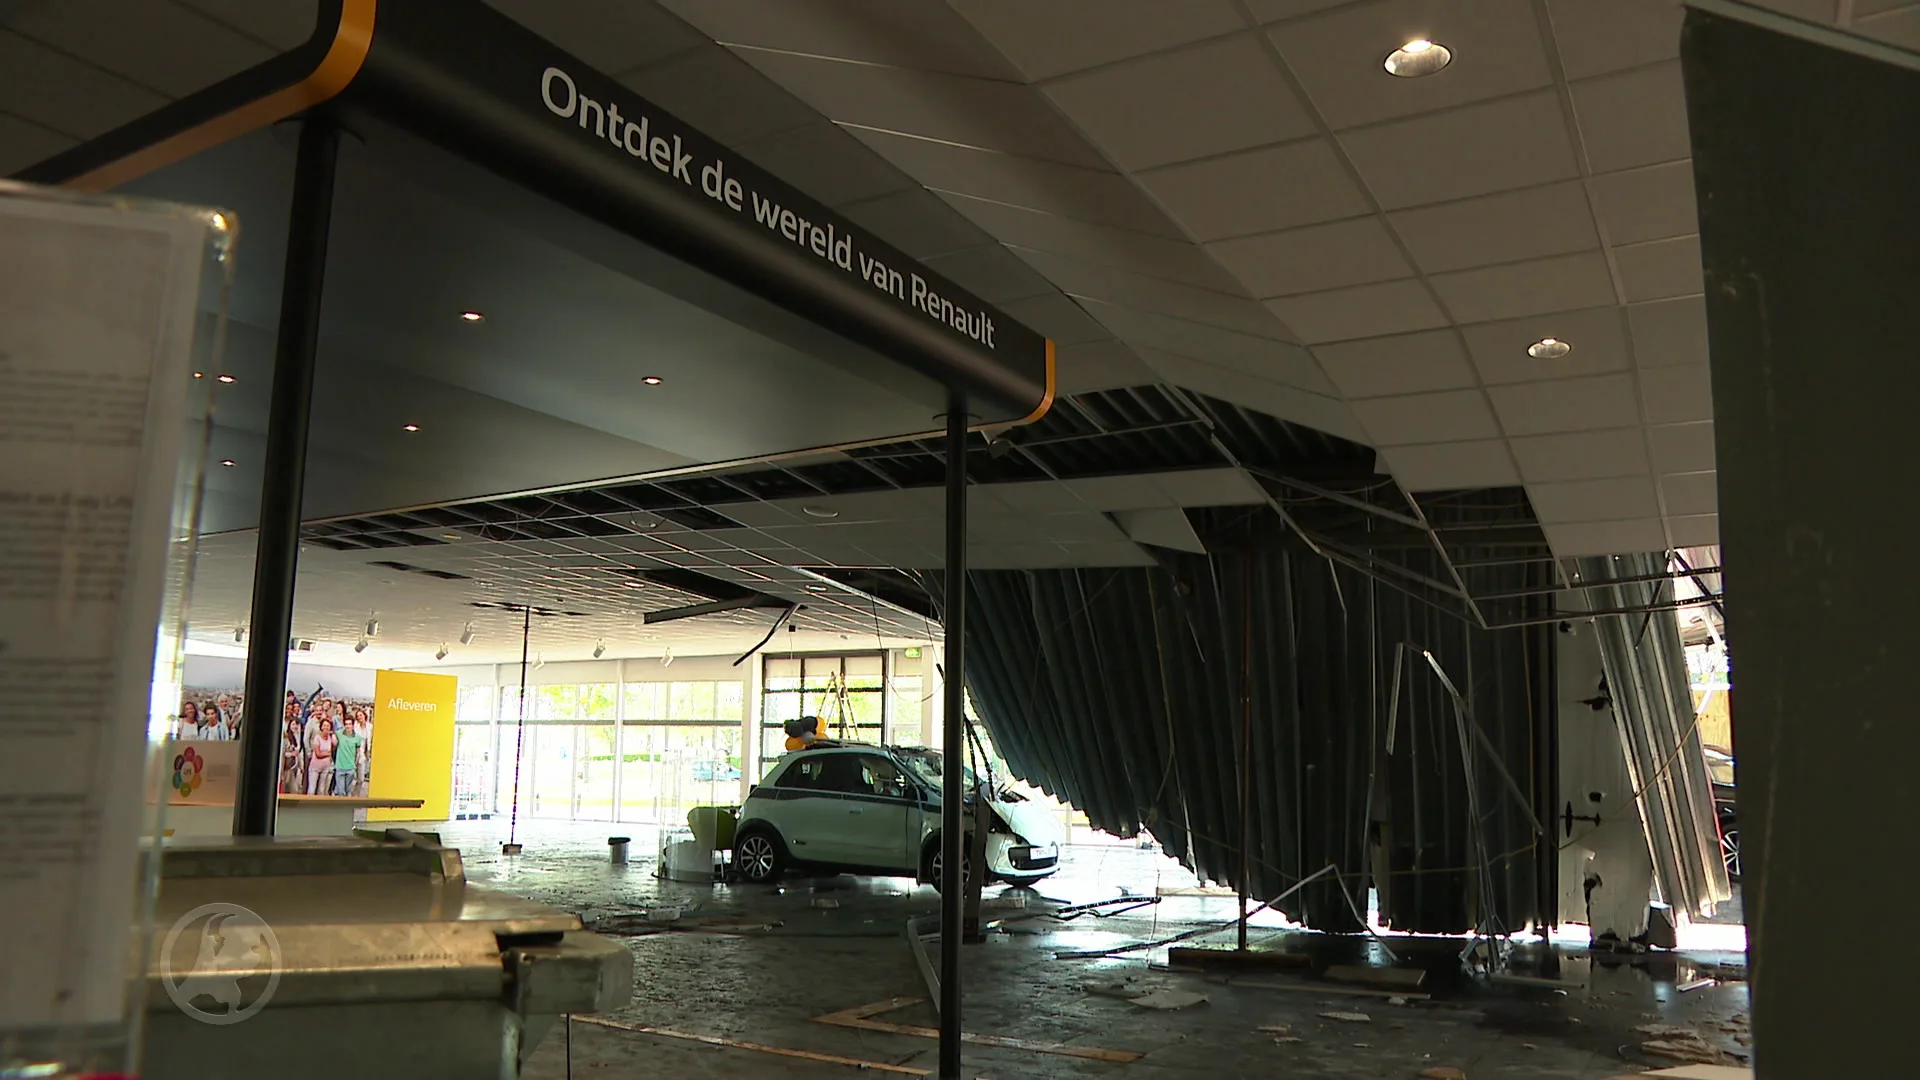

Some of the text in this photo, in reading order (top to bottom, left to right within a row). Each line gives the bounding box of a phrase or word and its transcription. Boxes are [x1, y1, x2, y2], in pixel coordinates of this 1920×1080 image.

[541, 67, 995, 349] Ontdek de wereld van Renault
[388, 698, 437, 712] Afleveren
